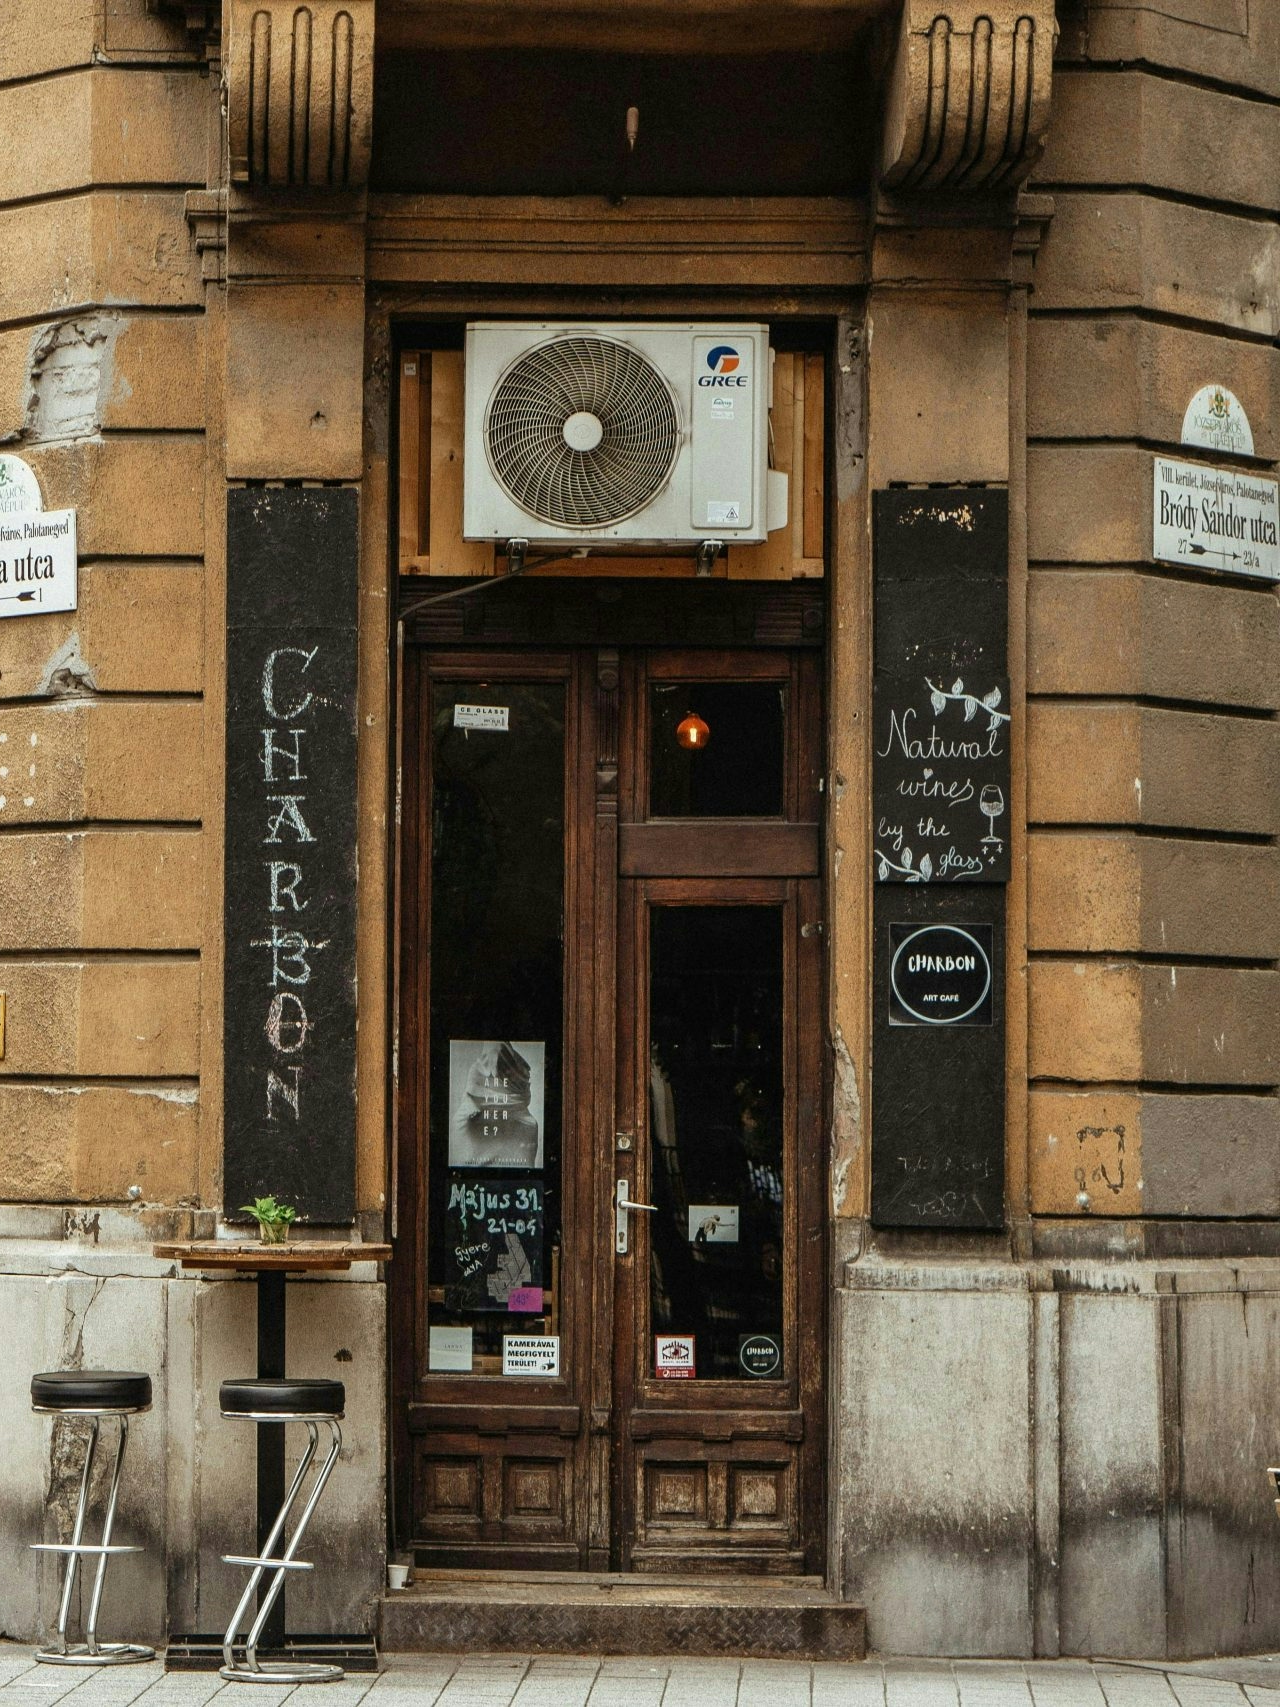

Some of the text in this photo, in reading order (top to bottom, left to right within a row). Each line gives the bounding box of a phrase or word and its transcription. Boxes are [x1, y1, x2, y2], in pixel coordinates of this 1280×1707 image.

[698, 375, 748, 387] GREE
[1161, 466, 1274, 505] VIII. kerület, Józsefváros, Palotanegyed
[1160, 490, 1277, 546] Bródy Sándor utca
[24, 519, 69, 539] Palotanegyed
[1178, 539, 1260, 568] 27 23/a
[14, 547, 55, 581] utca
[877, 708, 1003, 760] Natural
[896, 768, 974, 808] wines
[878, 816, 950, 851] by the
[939, 845, 983, 881] glass
[259, 646, 318, 1120] CHARBON
[908, 954, 975, 973] CHARBON
[923, 993, 959, 1002] ART CAFÉ
[484, 1078, 508, 1087] ARE
[484, 1094, 508, 1104] YOU
[483, 1110, 508, 1120] HER
[483, 1126, 498, 1136] E?
[448, 1183, 542, 1220] Május 31.
[508, 1340, 555, 1348] KAMERÁVAL
[508, 1350, 555, 1358] MEGFIGYELT
[508, 1359, 537, 1367] TERÜLET!
